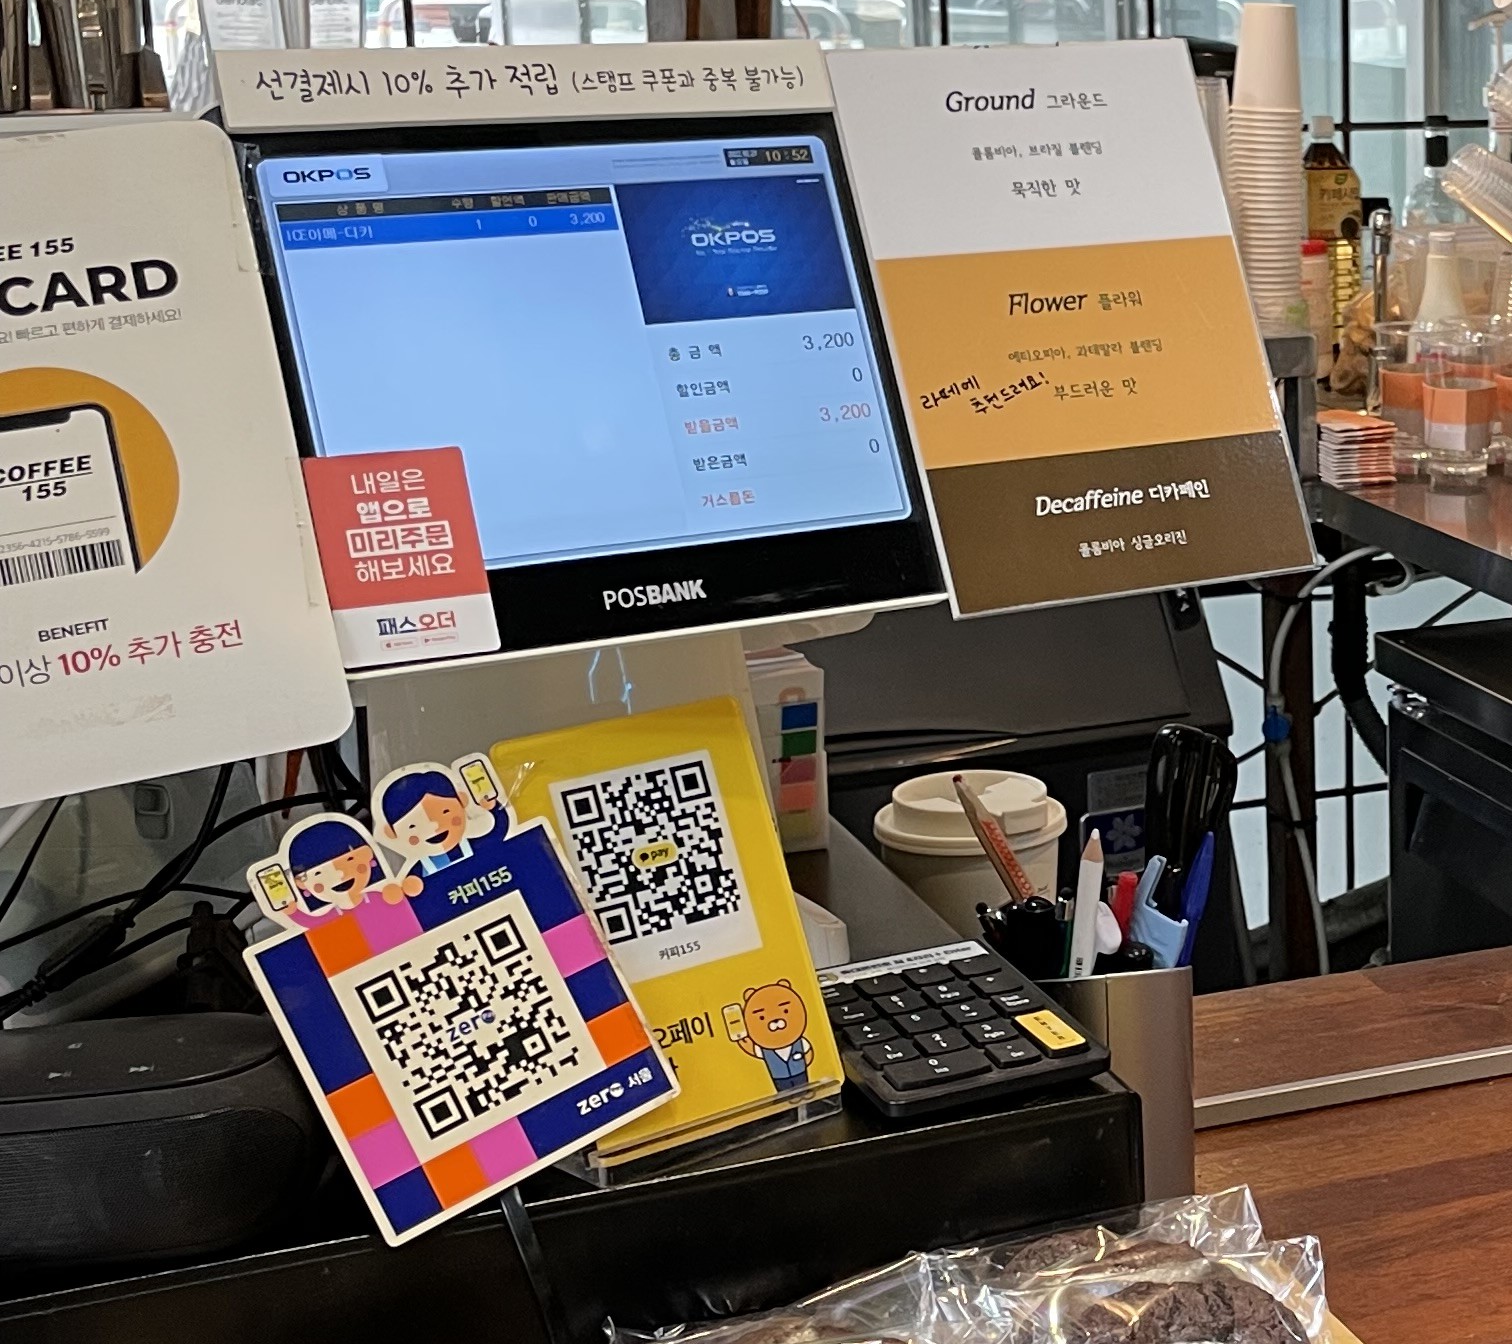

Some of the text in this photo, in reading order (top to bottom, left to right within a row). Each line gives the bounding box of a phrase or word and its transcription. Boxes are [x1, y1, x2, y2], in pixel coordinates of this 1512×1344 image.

[256, 63, 804, 103] 선결제시 10% 추가 적립 (스탬프 쿠폰과 중복 불가능)
[945, 88, 1108, 113] Ground 그라운드
[282, 167, 372, 184] OKPOS
[1011, 177, 1081, 198] 묵직한 맛
[30, 237, 75, 257] 155
[690, 229, 776, 247] OKPOS
[0, 259, 178, 316] CARD
[1008, 290, 1143, 316] Flower 플라워
[15, 326, 60, 340] 빠르고
[62, 317, 105, 335] 편하게
[802, 332, 854, 353] 3,200
[852, 367, 863, 383] 0
[1054, 376, 1138, 401] 부드러운 맛
[819, 403, 872, 424] 3,200
[868, 439, 879, 455] 0
[22, 481, 68, 502] 155
[351, 468, 425, 495] 내일은
[356, 497, 432, 524] 앱으로
[1035, 479, 1211, 517] Decaffeine 디카페인
[350, 523, 449, 553] 미리주문
[1131, 529, 1188, 551] 싱글오리진
[354, 553, 456, 583] 해보세요
[603, 578, 707, 611] POSBANK
[38, 618, 109, 643] BENEFIT
[376, 611, 456, 636] 패스오더
[57, 644, 121, 676] 10%
[127, 631, 182, 665] 추가
[188, 619, 243, 654] 충전
[651, 846, 670, 860] pay
[448, 866, 513, 905] 커피155
[659, 940, 701, 960] 커피155
[627, 1067, 654, 1089] 서울
